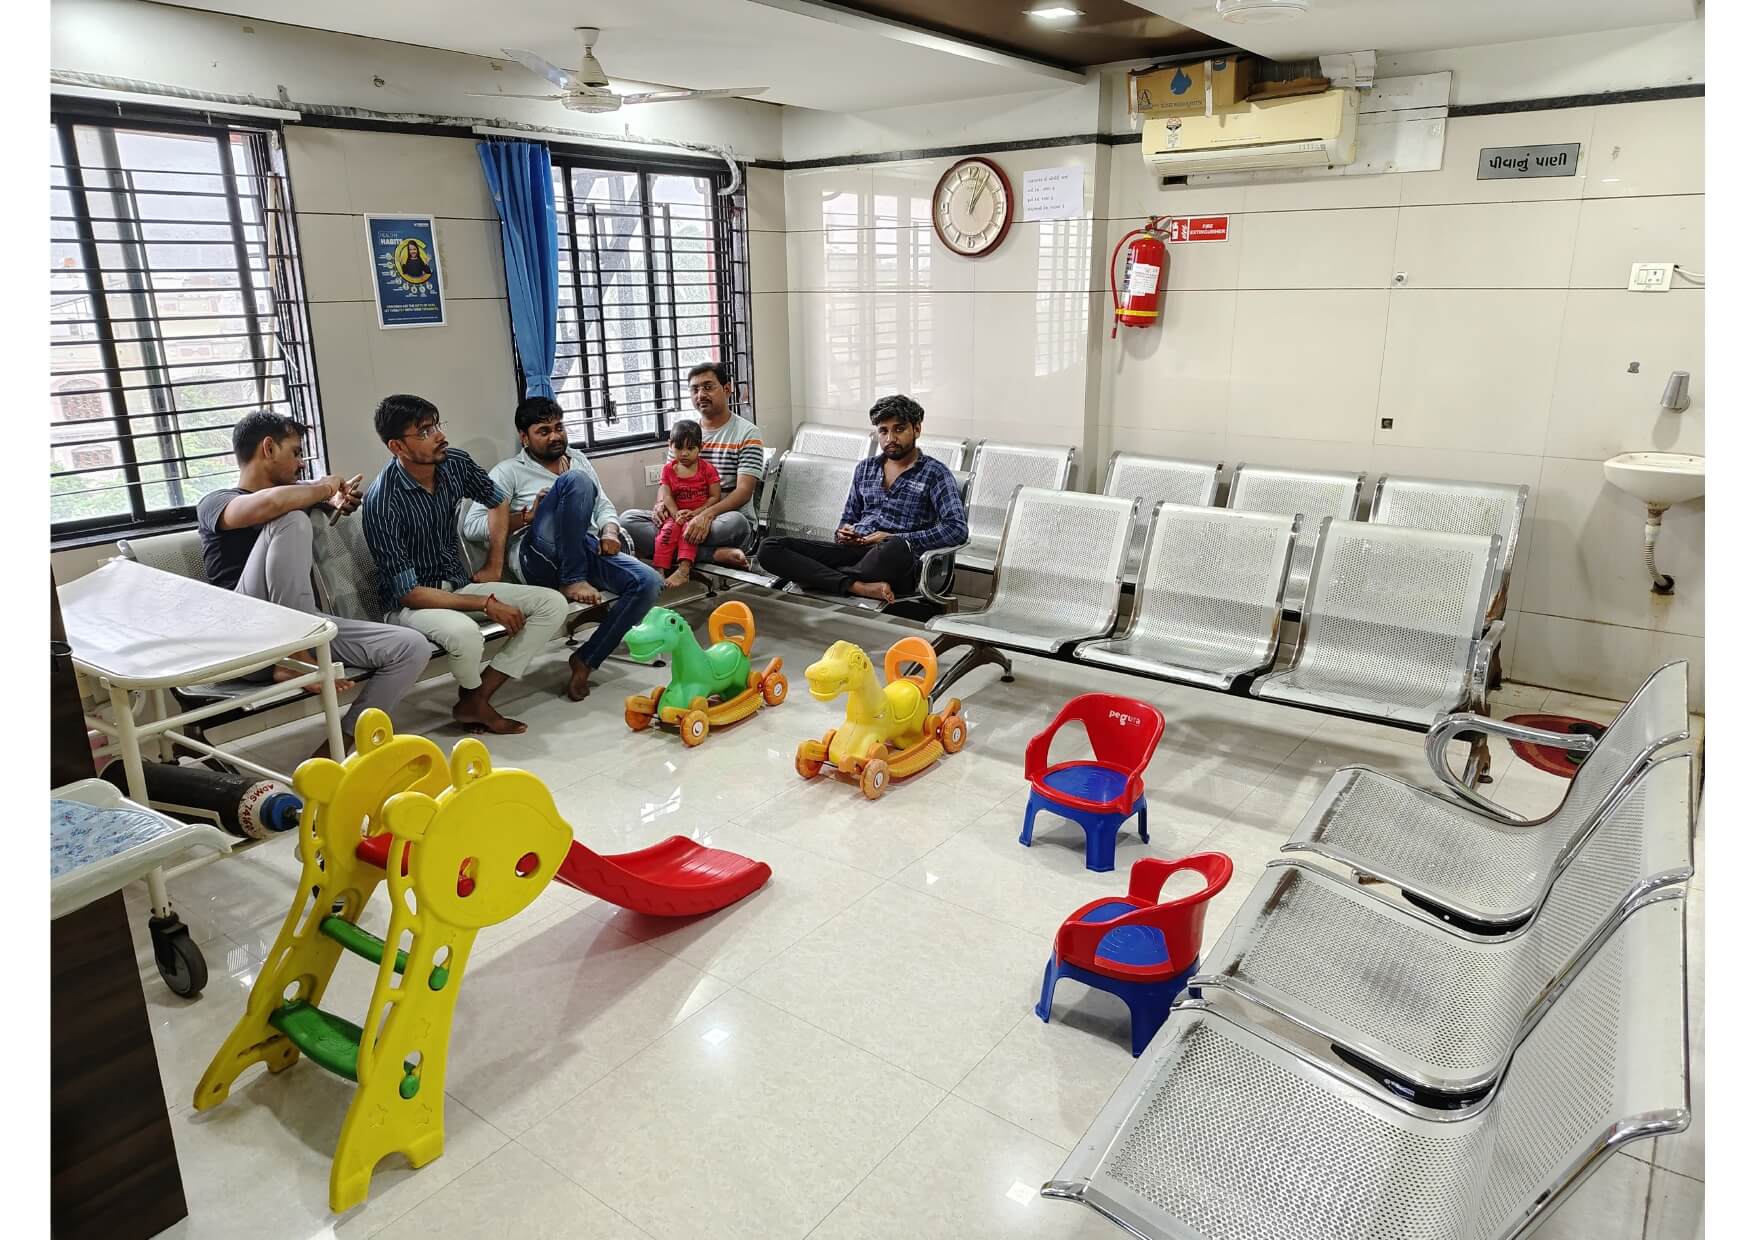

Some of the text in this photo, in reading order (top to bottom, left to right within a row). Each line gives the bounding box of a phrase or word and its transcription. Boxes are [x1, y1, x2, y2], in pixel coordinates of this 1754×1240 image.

[1489, 152, 1567, 172] પીવાનું પાણી
[250, 784, 274, 801] ADMS
